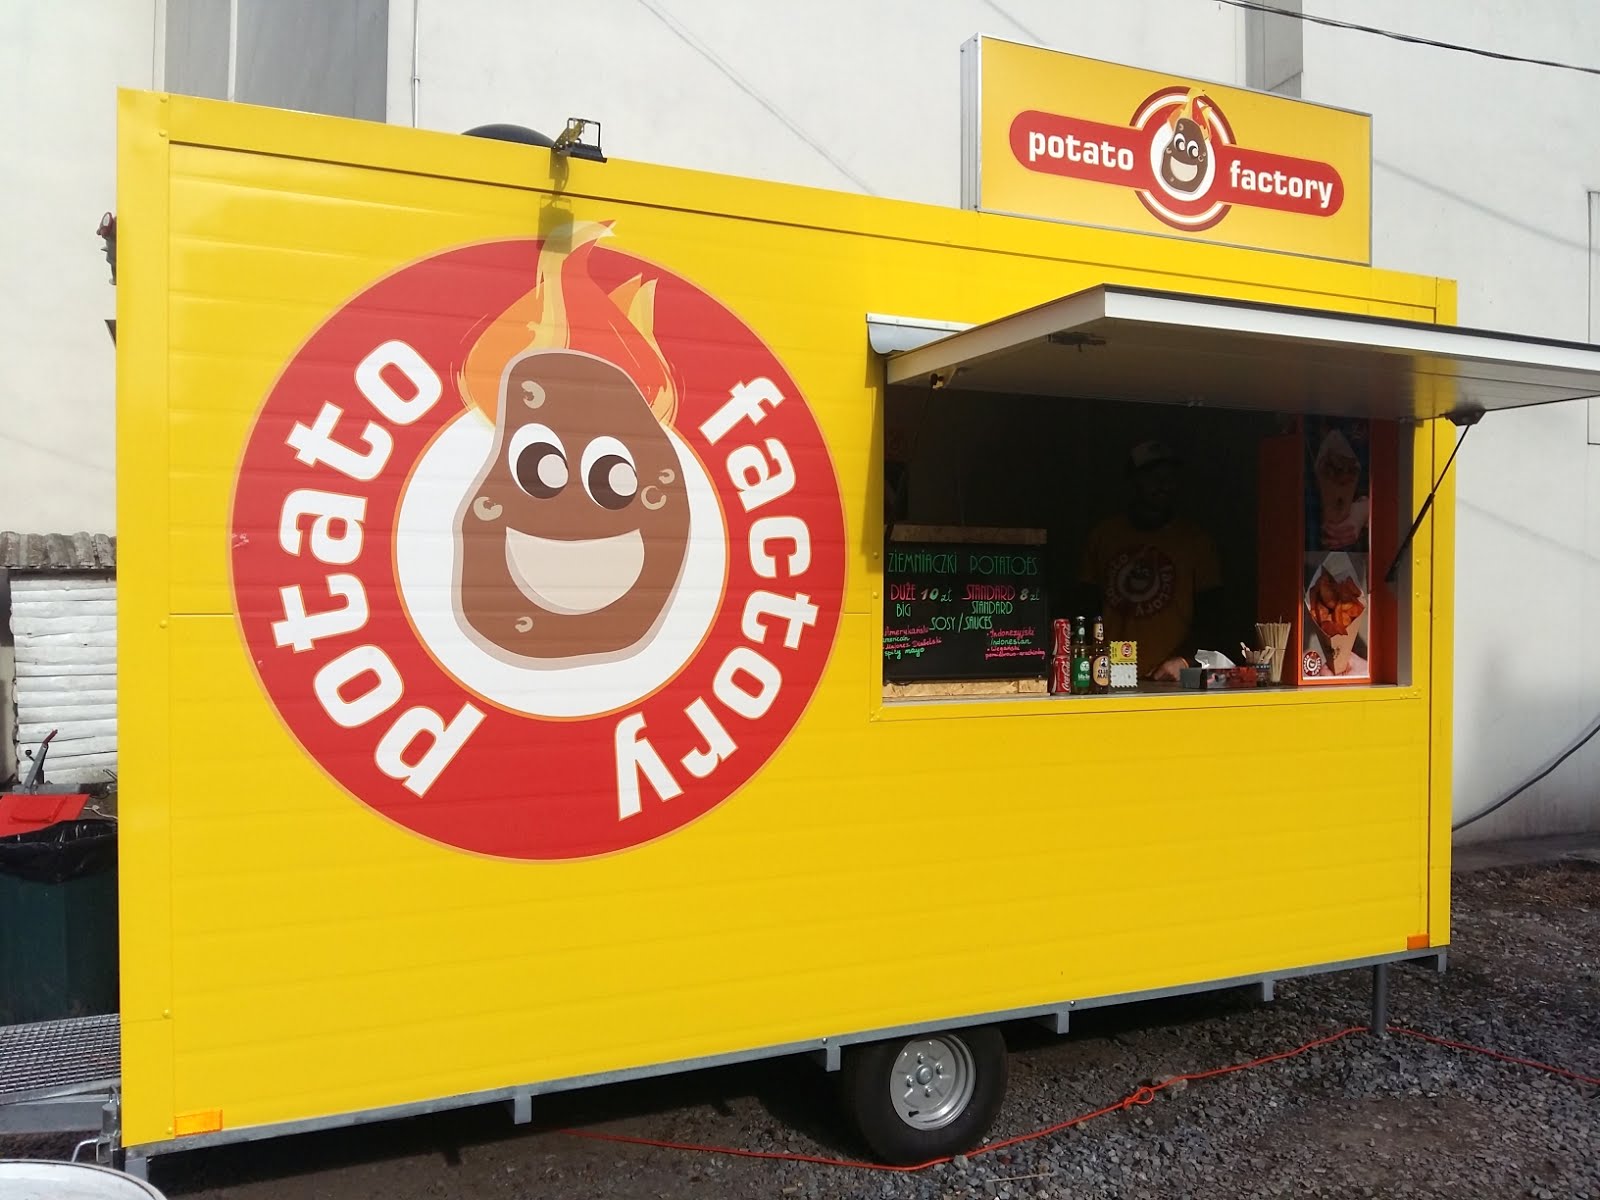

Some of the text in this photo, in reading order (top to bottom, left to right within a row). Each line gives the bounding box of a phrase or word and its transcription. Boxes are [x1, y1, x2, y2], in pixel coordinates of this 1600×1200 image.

[1028, 130, 1333, 209] potato factory
[970, 555, 1038, 575] POTATOES
[272, 338, 820, 822] potato factory
[920, 588, 939, 601] 10
[961, 584, 1016, 601] STANDARD
[1019, 588, 1029, 601] 8
[896, 602, 912, 618] BIG
[971, 600, 1014, 615] STANDARD
[904, 647, 926, 658] mayo
